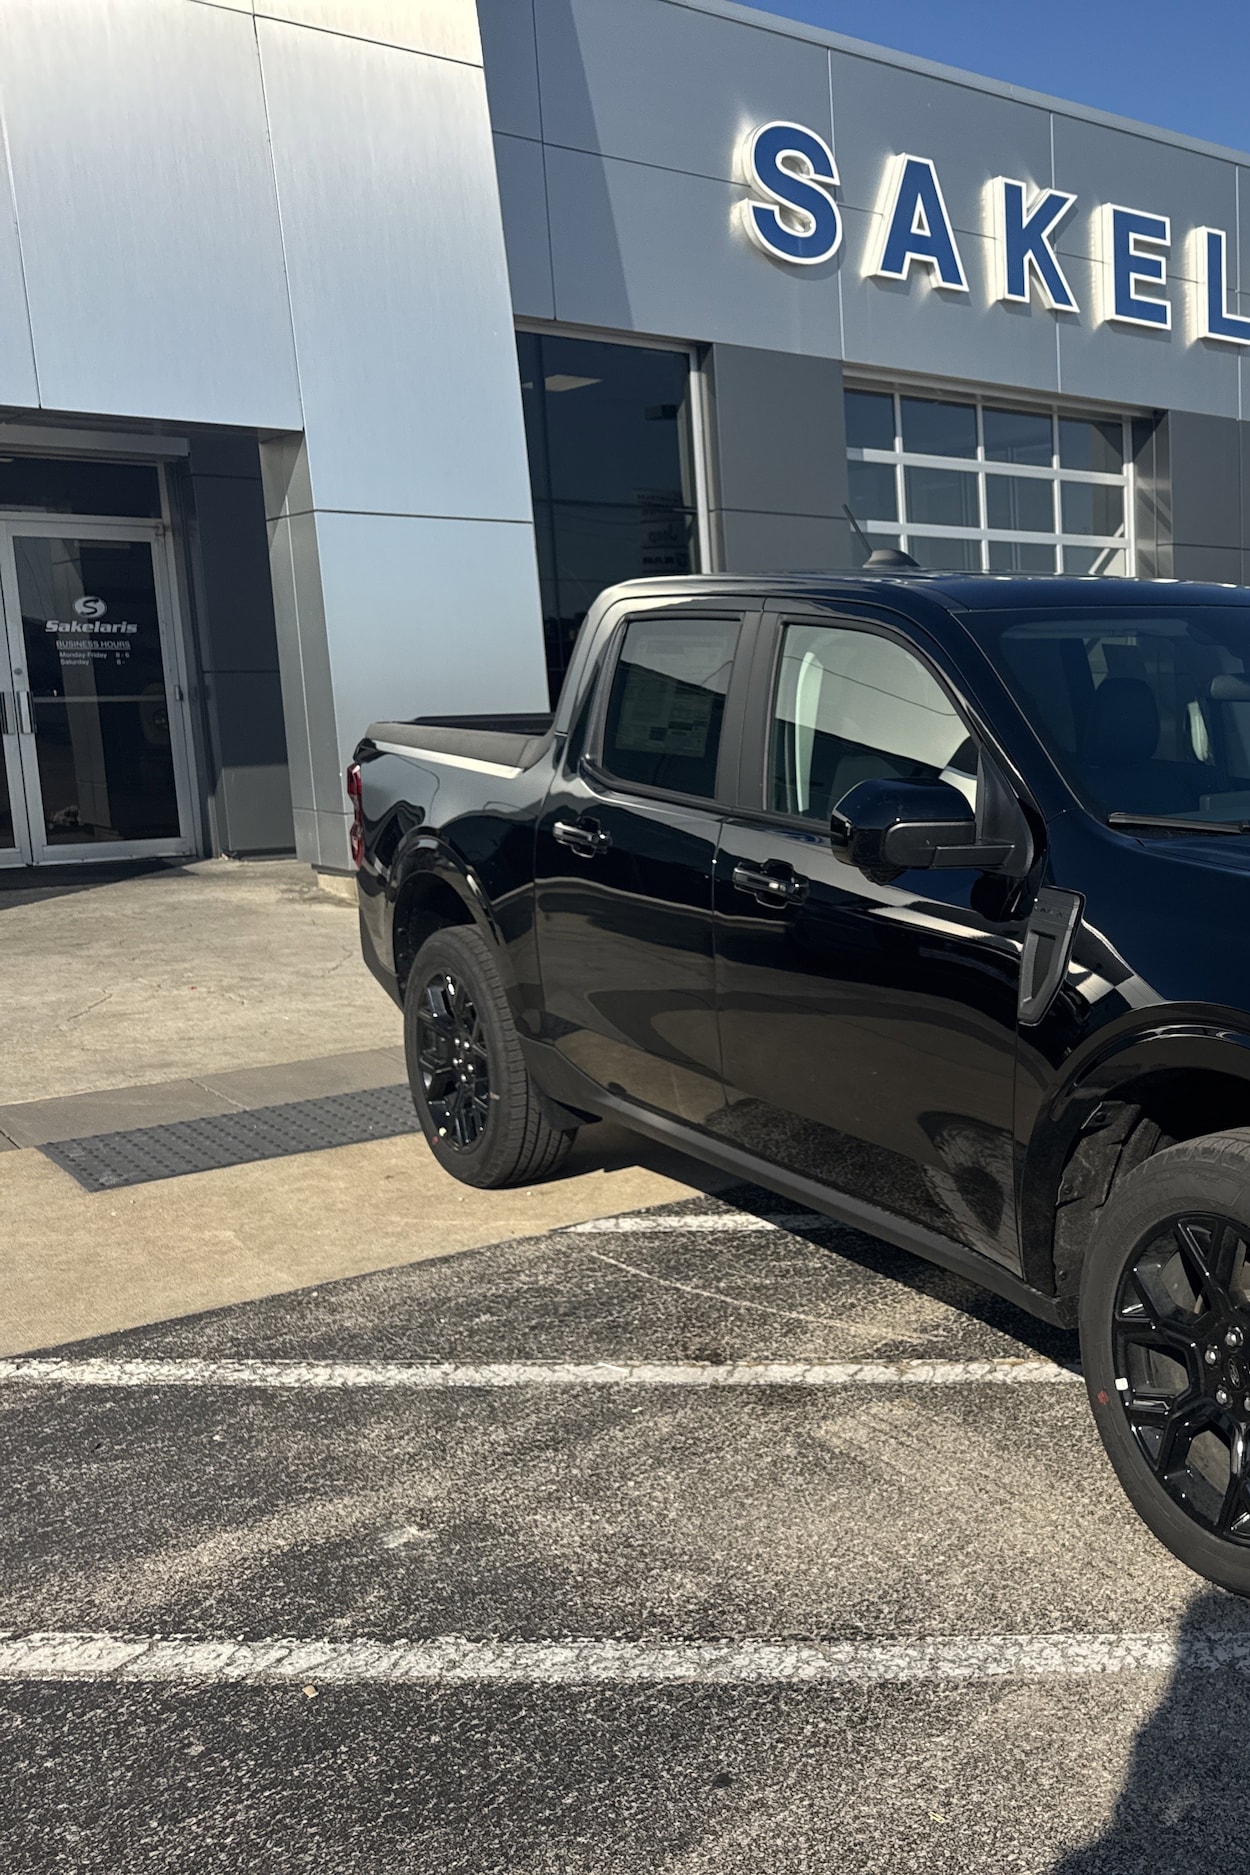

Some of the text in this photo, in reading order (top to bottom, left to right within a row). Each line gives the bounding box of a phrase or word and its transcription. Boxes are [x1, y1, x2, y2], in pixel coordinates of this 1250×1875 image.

[45, 620, 138, 633] Sakelaris
[56, 640, 131, 649] BUSINESS HOURS
